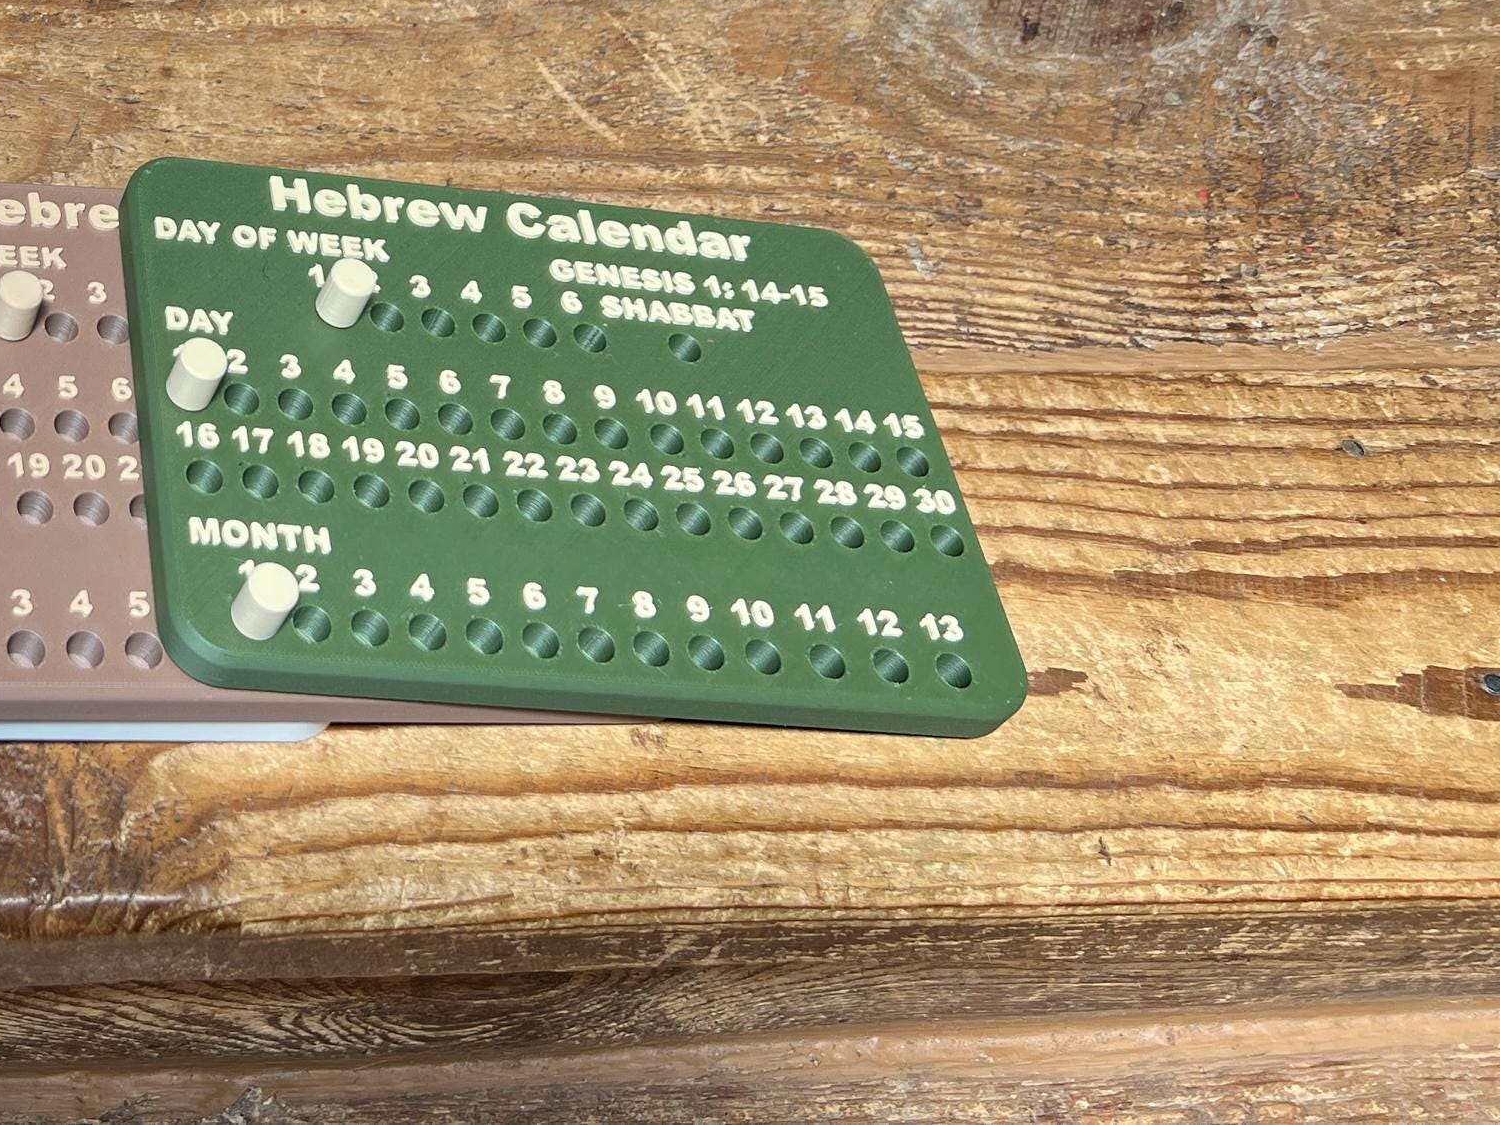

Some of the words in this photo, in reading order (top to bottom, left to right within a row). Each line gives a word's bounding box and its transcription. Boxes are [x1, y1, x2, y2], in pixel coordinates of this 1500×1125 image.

[153, 216, 221, 245] DAY
[231, 224, 277, 251] OF
[286, 229, 391, 263] WEEK
[269, 175, 488, 232] Hebrew
[506, 202, 751, 262] Calendar
[409, 274, 432, 299] 3
[460, 280, 483, 305] 4
[511, 285, 533, 309] 5
[560, 290, 583, 315] 6
[599, 294, 755, 333] SHABBAT
[549, 258, 696, 296] GENESIS
[164, 305, 234, 336] DAY
[226, 348, 249, 374] 2
[279, 353, 302, 379] 3
[332, 359, 356, 385] 4
[386, 364, 408, 390] 5
[438, 370, 462, 395] 6
[489, 374, 512, 400] 7
[543, 379, 566, 405] 8
[593, 384, 617, 409] 9
[635, 388, 677, 416] 10
[686, 393, 726, 421] 11
[736, 398, 780, 426] 12
[785, 403, 828, 430] 13
[835, 407, 877, 435] 14
[883, 412, 925, 440] 15
[176, 420, 220, 450] 16
[232, 425, 274, 454] 17
[287, 430, 331, 459] 18
[342, 435, 386, 464] 19
[395, 440, 440, 469] 20
[448, 445, 492, 475] 21
[502, 450, 549, 479] 22
[555, 455, 601, 483] 23
[608, 460, 654, 489] 24
[660, 464, 705, 493] 25
[712, 470, 757, 498] 26
[763, 475, 803, 502] 27
[813, 478, 858, 507] 28
[863, 483, 907, 511] 29
[913, 488, 957, 516] 30
[187, 516, 333, 556] MONTH
[295, 563, 321, 593] 2
[352, 568, 378, 598] 3
[409, 573, 436, 603] 4
[467, 577, 491, 607] 5
[522, 582, 547, 611] 6
[576, 585, 599, 614] 7
[631, 590, 658, 619] 8
[686, 595, 711, 623] 9
[730, 597, 775, 628] 10
[794, 603, 837, 634] 11
[856, 608, 905, 638] 12
[919, 612, 965, 643] 13
